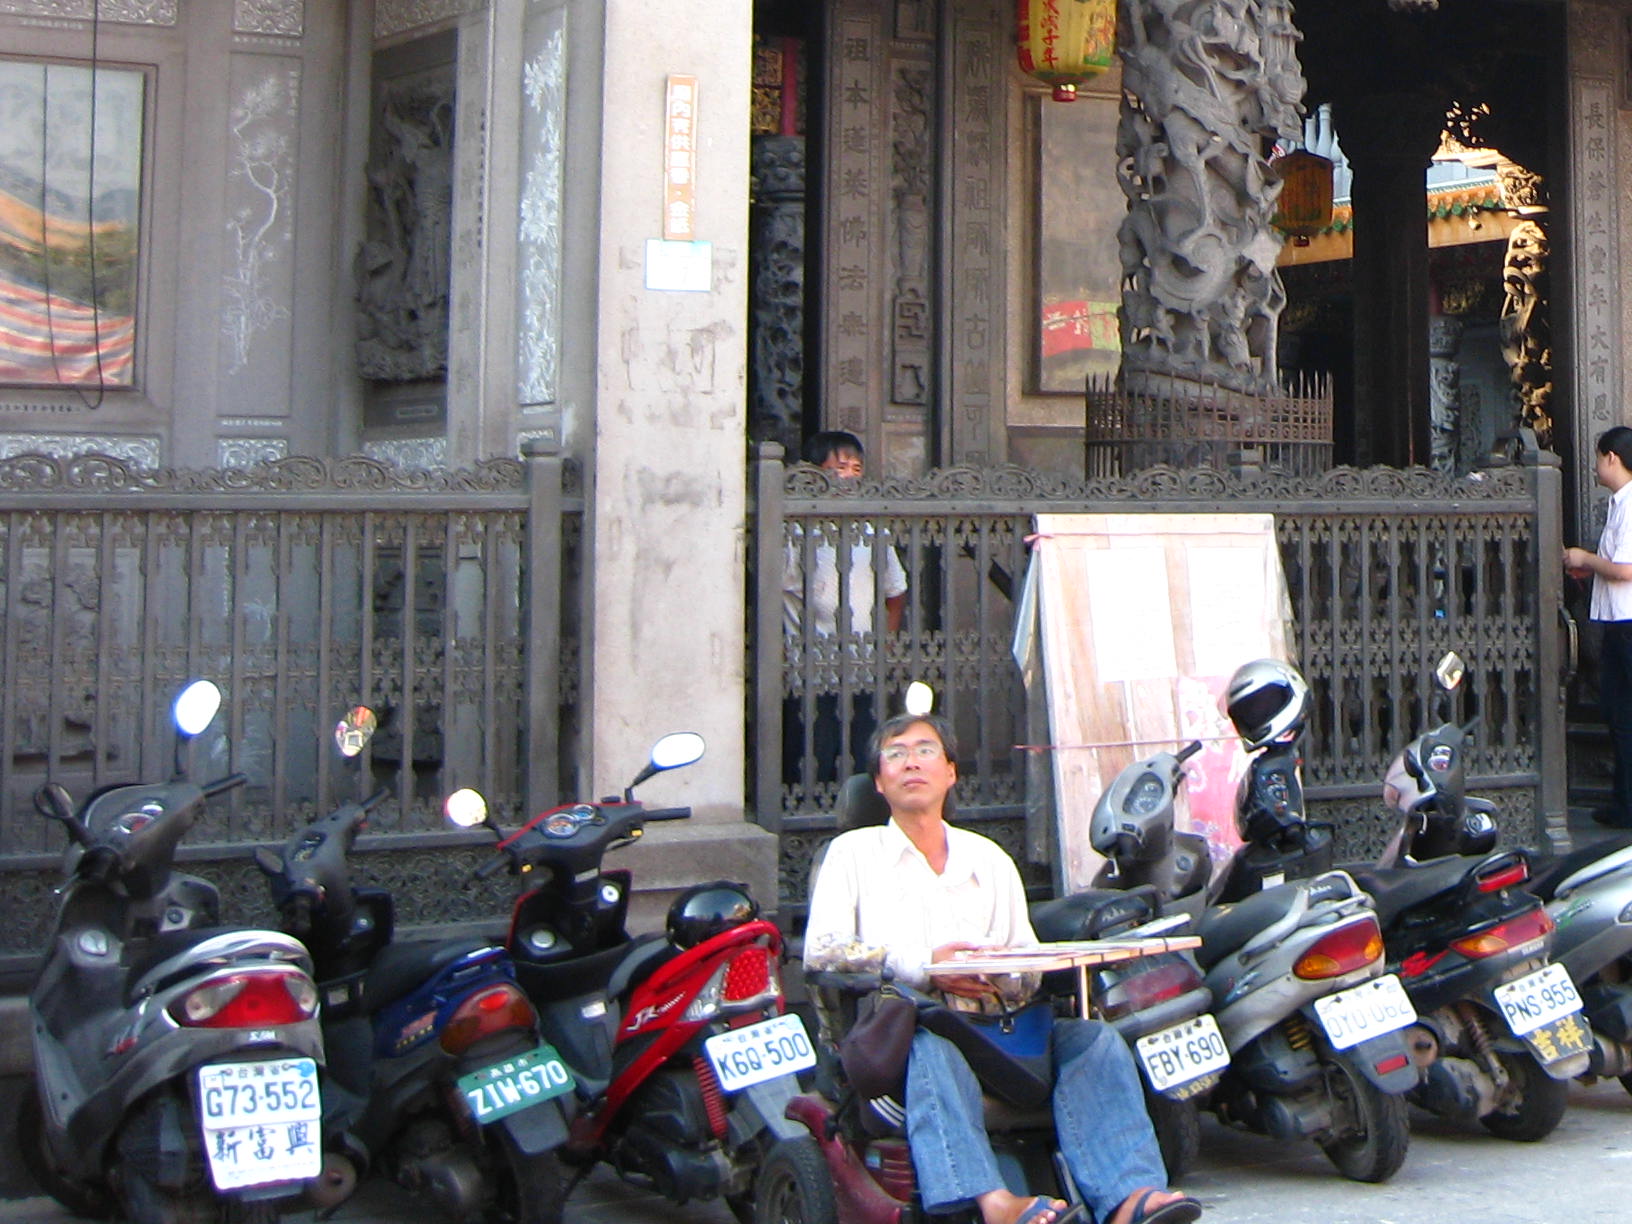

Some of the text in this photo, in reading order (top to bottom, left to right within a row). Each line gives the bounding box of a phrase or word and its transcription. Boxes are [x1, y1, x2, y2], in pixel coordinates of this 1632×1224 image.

[1504, 978, 1577, 1027] PNS-955
[1147, 1031, 1225, 1080] FBY-690
[205, 1079, 316, 1118] G73-552
[467, 1059, 569, 1116] ZIW-670
